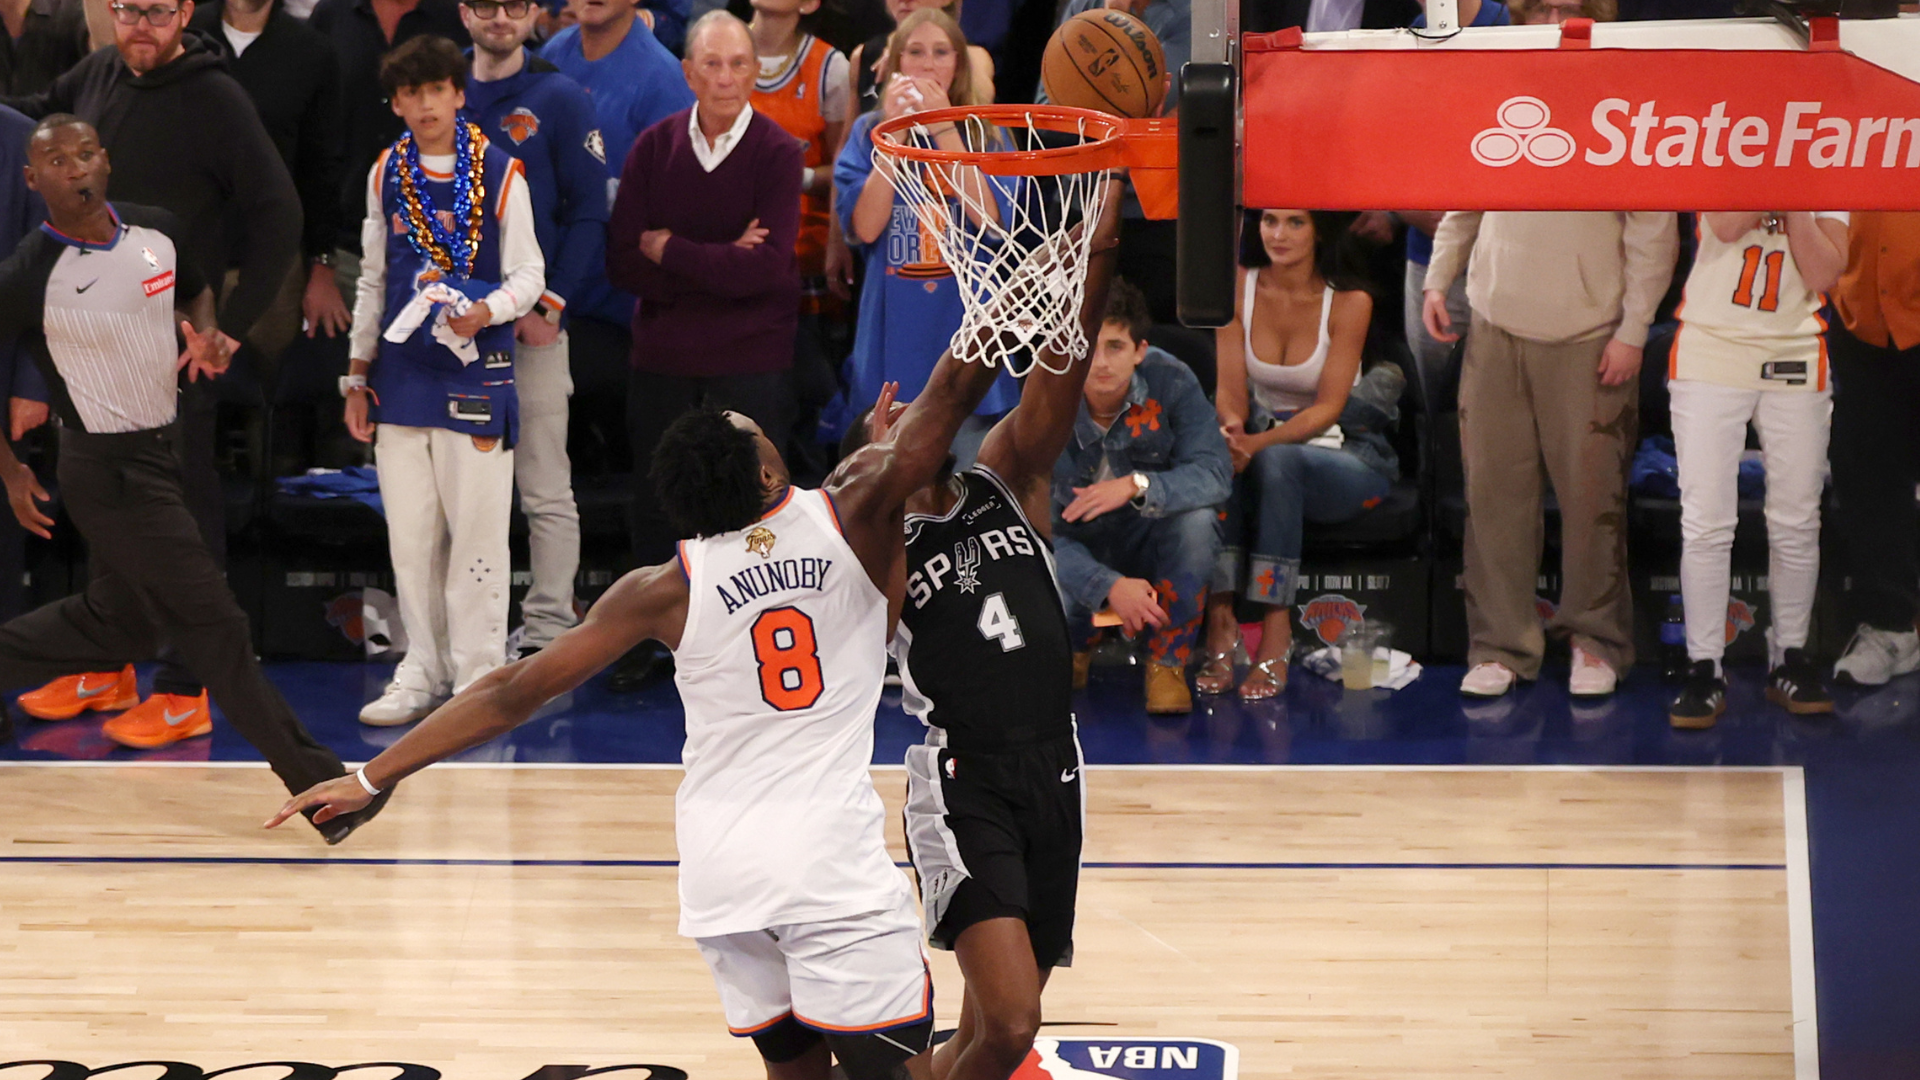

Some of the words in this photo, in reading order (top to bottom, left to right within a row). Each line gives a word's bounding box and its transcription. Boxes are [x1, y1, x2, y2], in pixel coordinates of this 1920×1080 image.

[1103, 13, 1158, 80] Wilson
[1732, 245, 1785, 312] 11
[966, 499, 997, 521] LEDGER
[716, 558, 832, 615] ANUNOBY
[904, 525, 1036, 609] SPURS
[976, 592, 1025, 652] 4
[750, 605, 825, 711] 8
[1088, 1046, 1198, 1070] NBA
